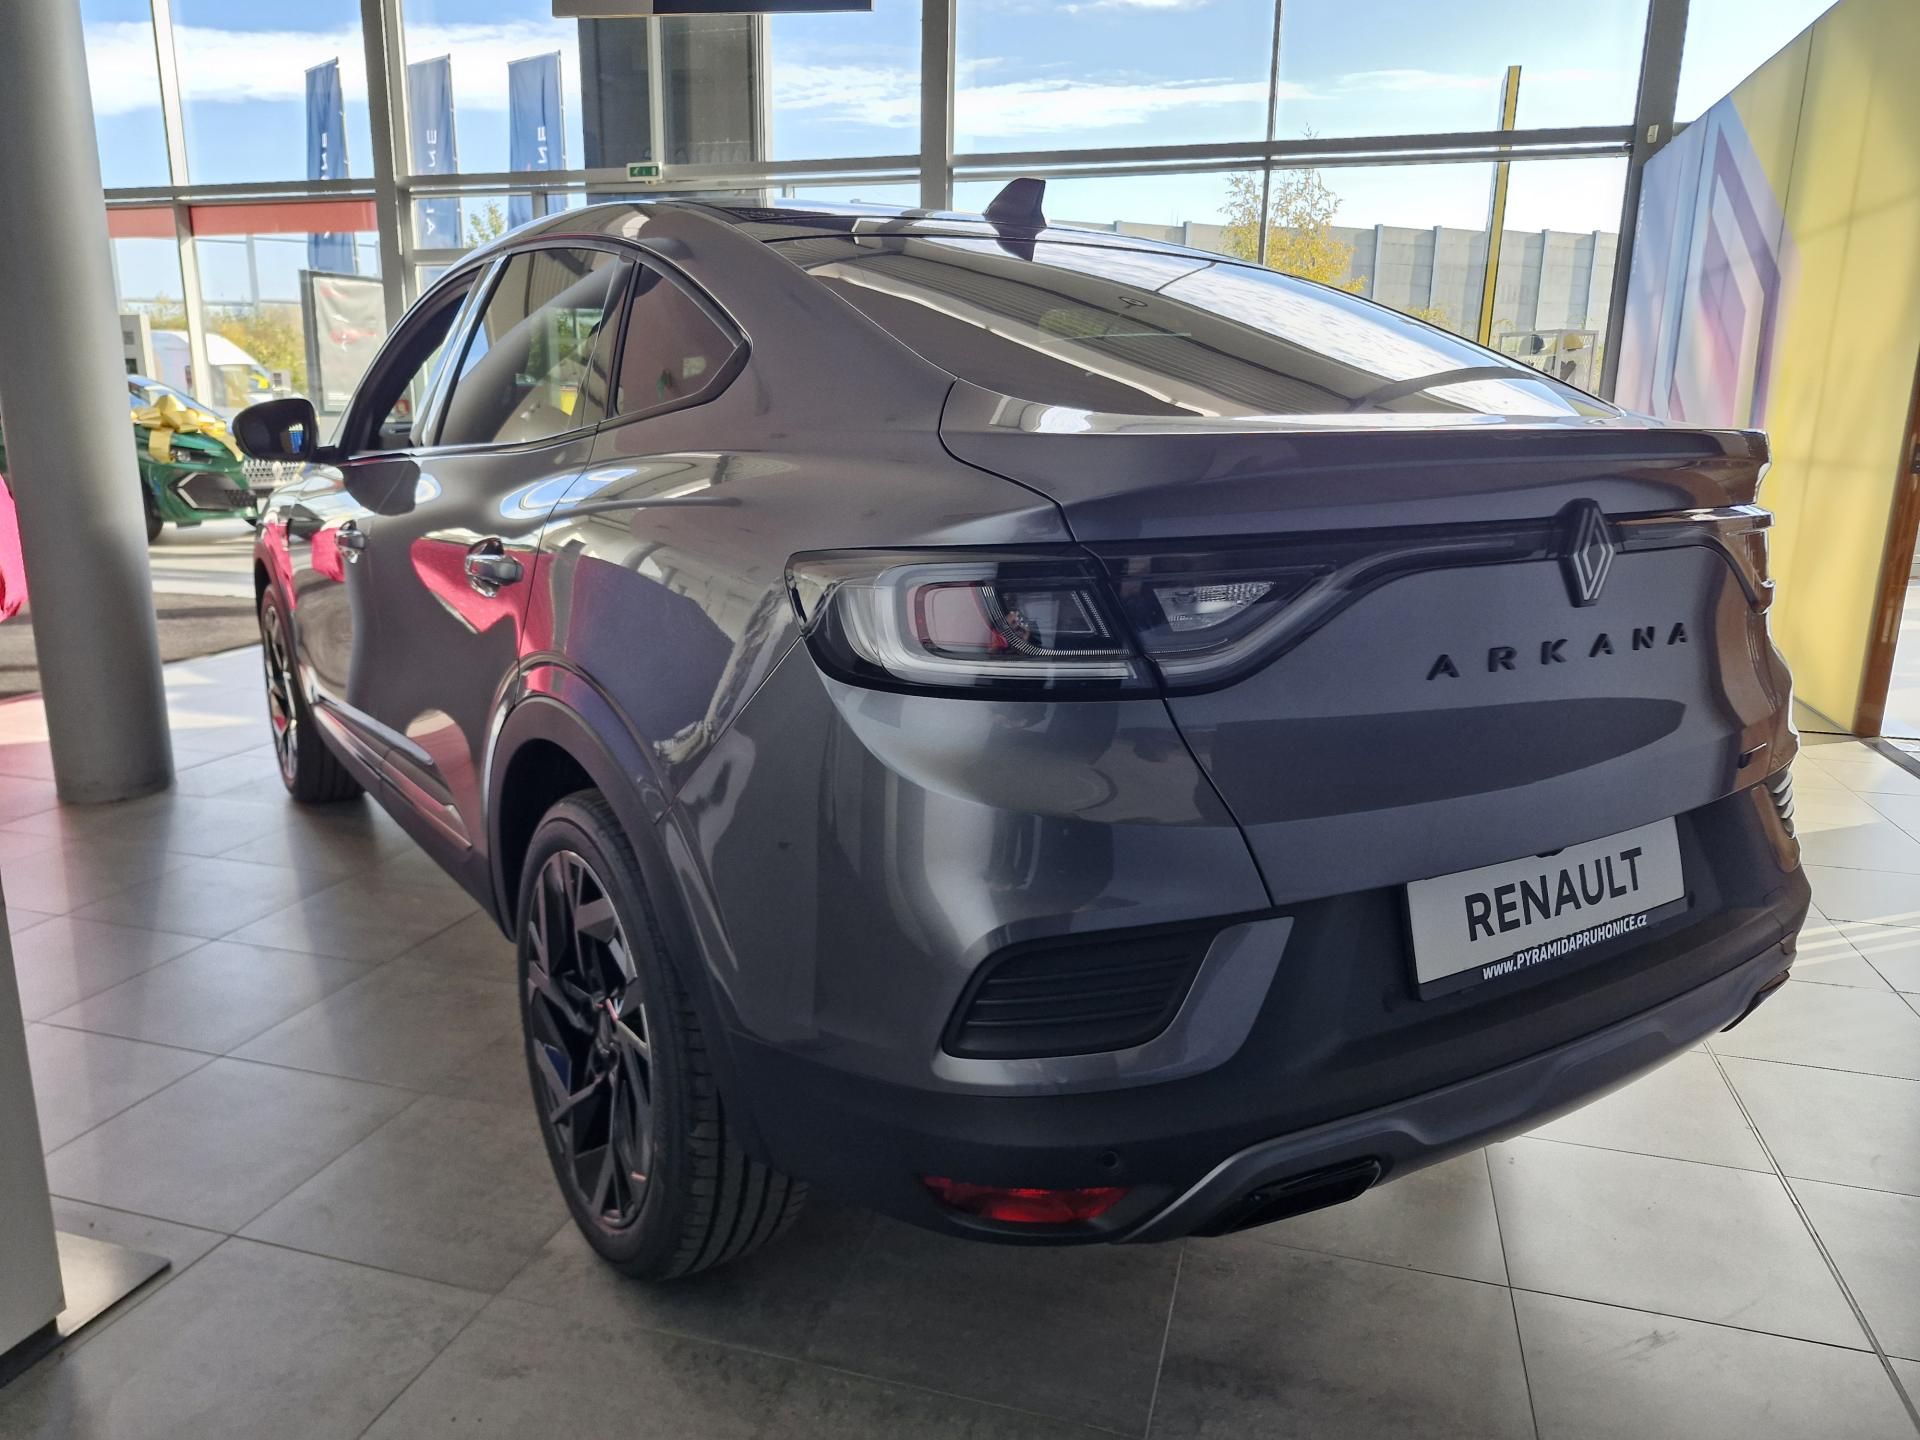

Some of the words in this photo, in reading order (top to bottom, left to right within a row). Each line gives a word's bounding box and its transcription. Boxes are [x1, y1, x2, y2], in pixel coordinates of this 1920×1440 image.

[1426, 622, 1689, 681] ARKANA
[1464, 846, 1643, 942] RENAULT
[1482, 914, 1647, 980] www.PYRAMIDAPRUHONICE.cz
